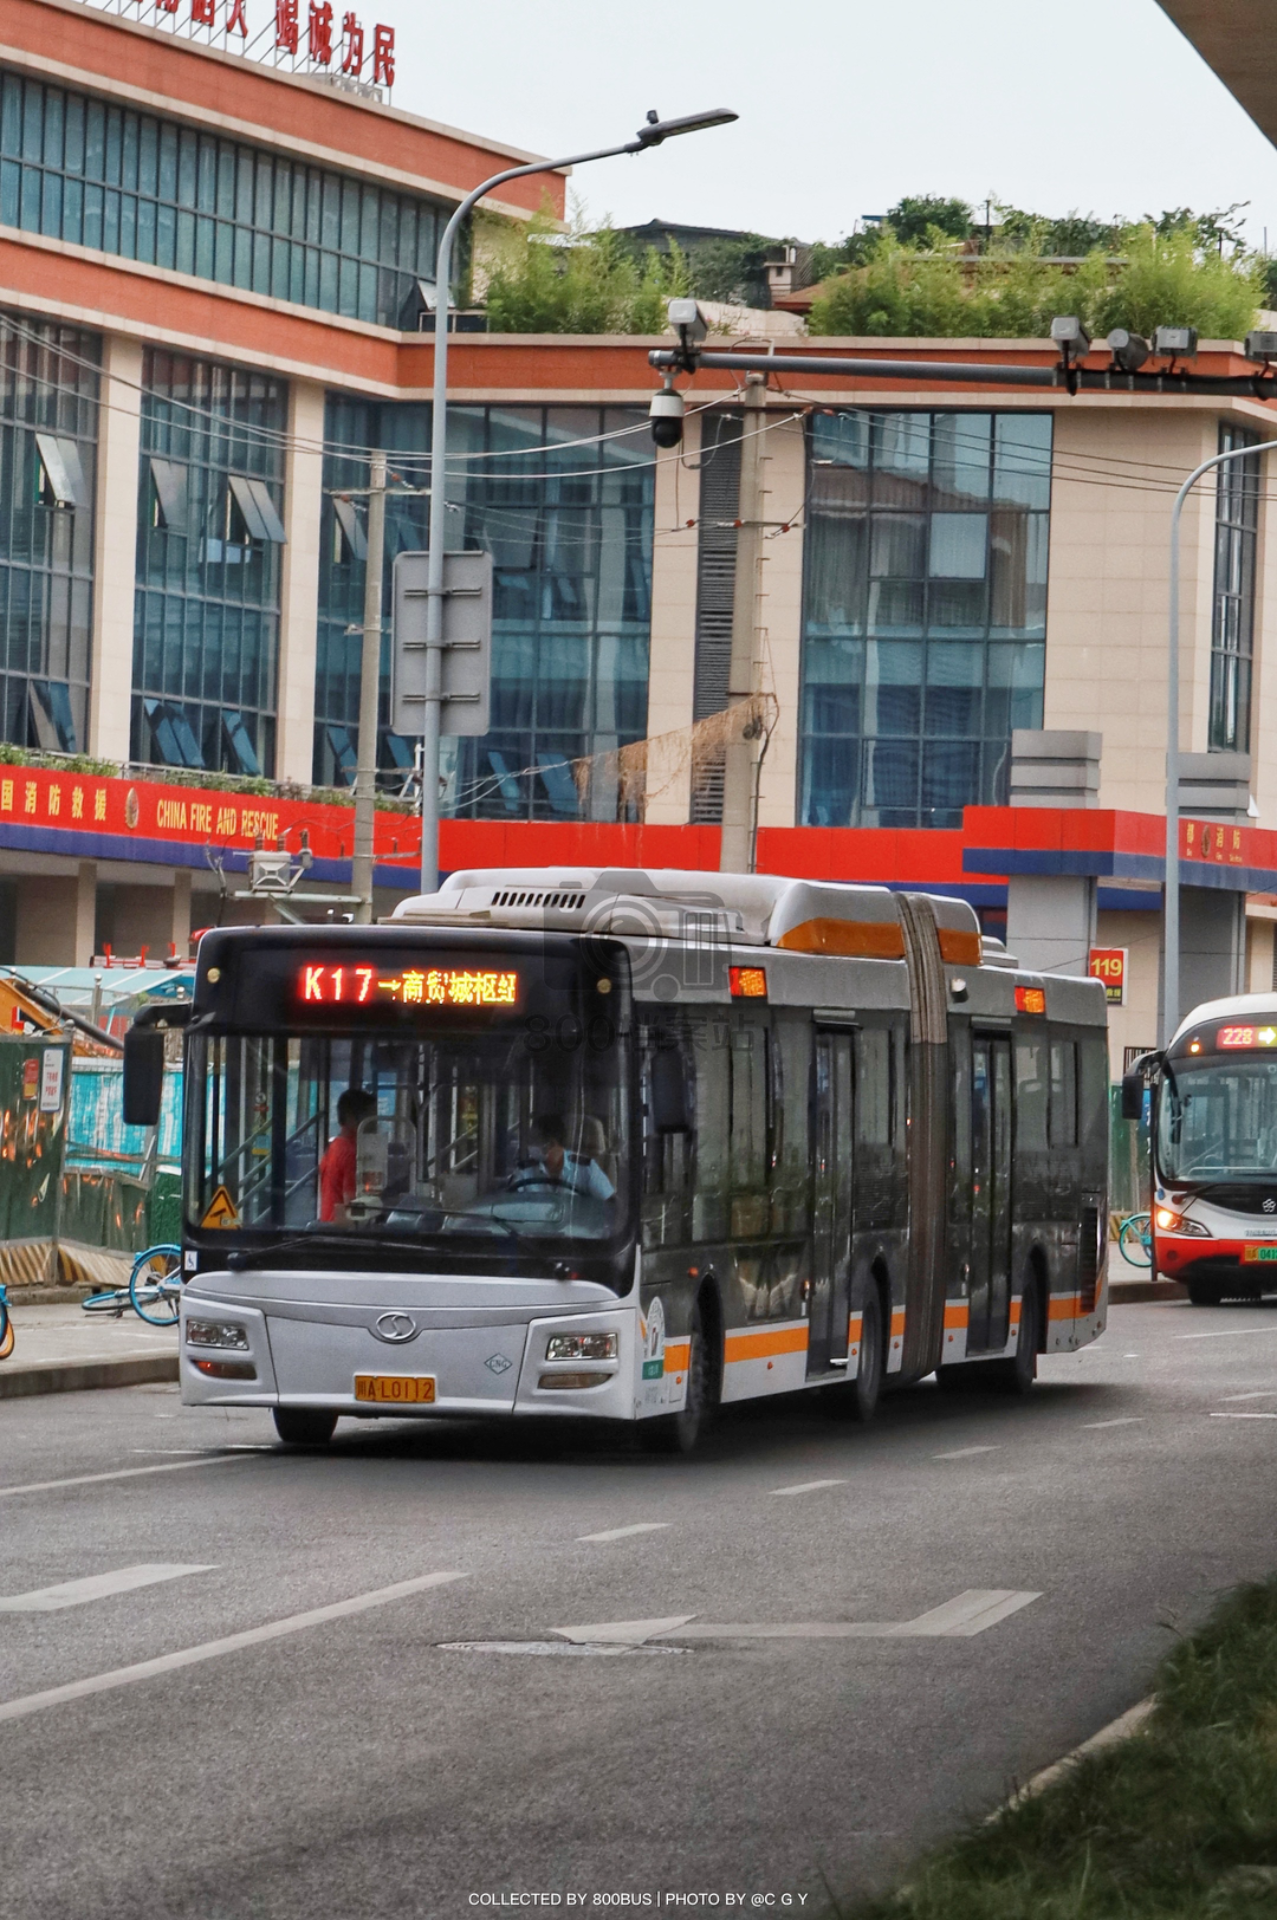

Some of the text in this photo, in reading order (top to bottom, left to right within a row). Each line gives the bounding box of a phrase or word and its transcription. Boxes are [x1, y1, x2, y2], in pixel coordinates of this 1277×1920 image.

[276, 0, 395, 87] 竭诚为民
[1, 780, 107, 821] 国消防救援
[157, 799, 278, 840] CHINA FIRE AND RESCUE
[305, 967, 372, 1001] K17
[1091, 959, 1122, 977] 119
[1223, 1028, 1254, 1045] 228
